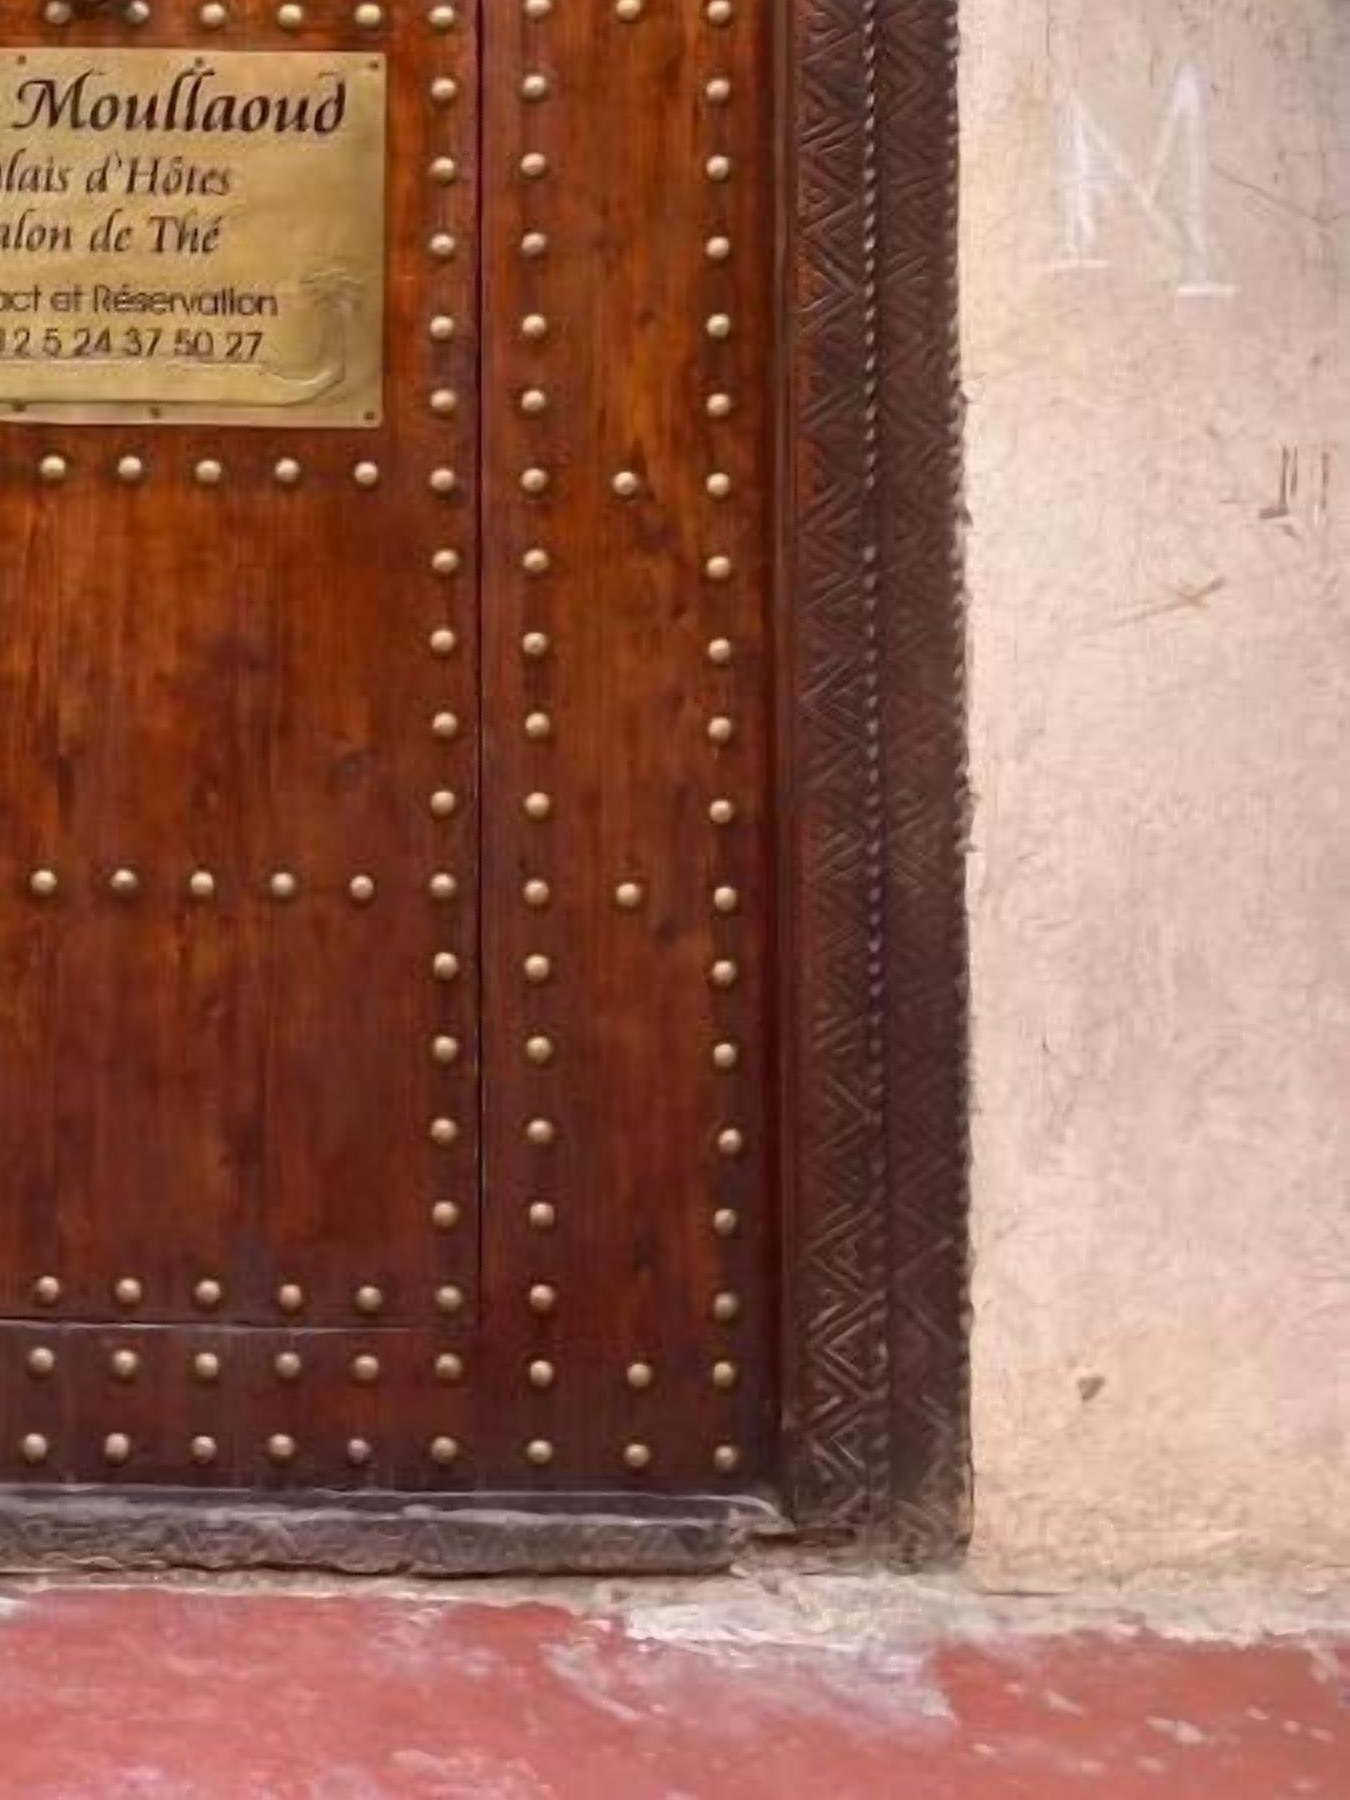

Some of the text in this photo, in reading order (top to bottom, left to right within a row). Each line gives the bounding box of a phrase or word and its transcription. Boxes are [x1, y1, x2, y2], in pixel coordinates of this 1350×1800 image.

[12, 68, 347, 135] Moullaoud
[85, 151, 233, 196] d'Hôtes
[88, 209, 131, 253] de
[149, 214, 222, 256] Thé
[50, 284, 84, 313] et
[93, 283, 278, 317] Réservation
[43, 327, 62, 356] 5
[73, 327, 112, 356] 24
[125, 327, 162, 357] 37
[174, 329, 214, 358] 50
[224, 330, 263, 358] 27
